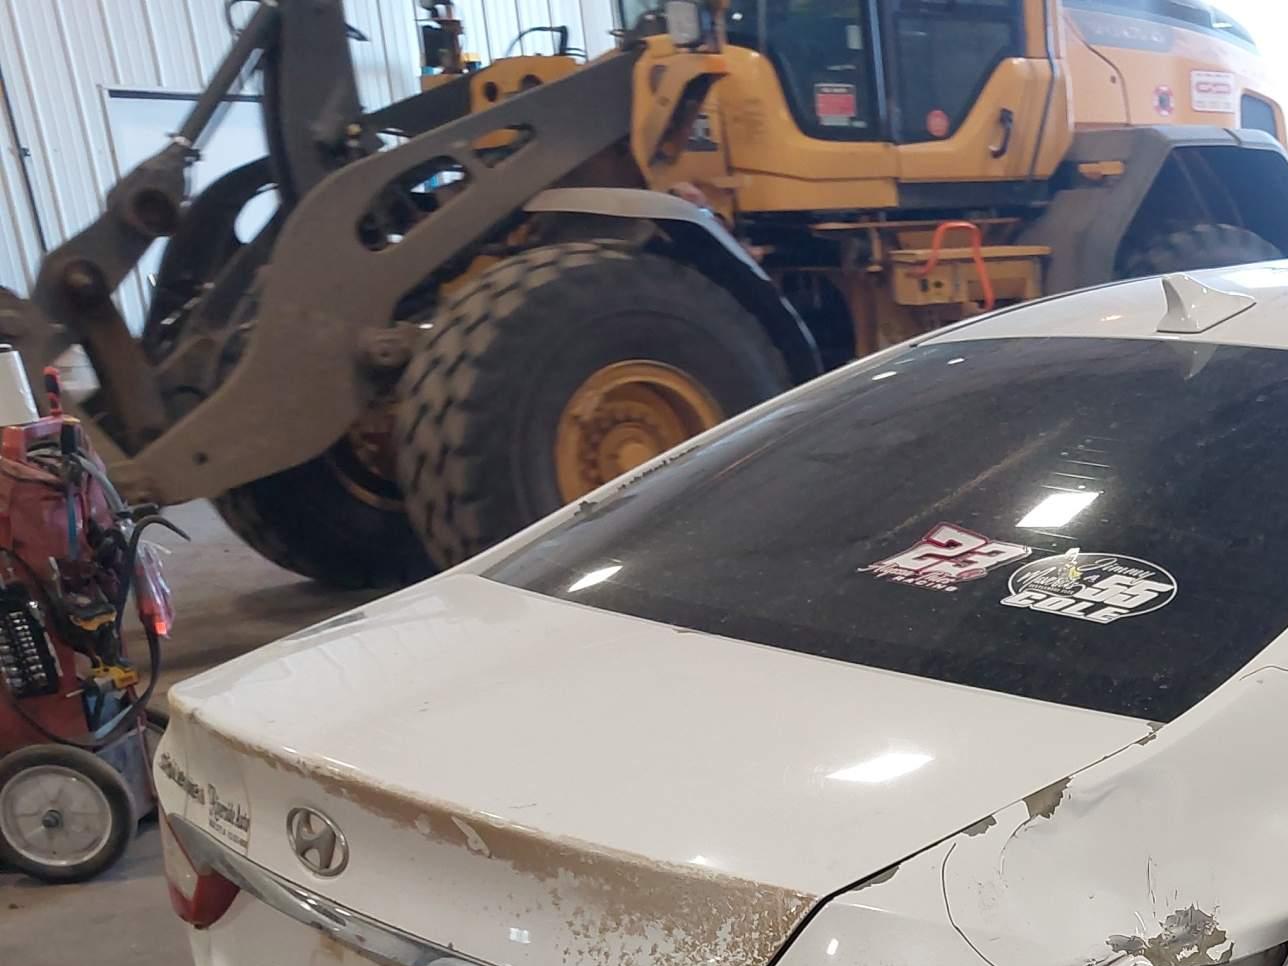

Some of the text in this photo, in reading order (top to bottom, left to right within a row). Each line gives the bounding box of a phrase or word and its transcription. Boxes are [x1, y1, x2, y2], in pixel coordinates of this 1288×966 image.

[884, 523, 1031, 578] 23
[893, 576, 959, 592] RACING
[1077, 557, 1156, 585] Jimmy
[1001, 590, 1132, 623] COLE
[1073, 574, 1174, 609] 55
